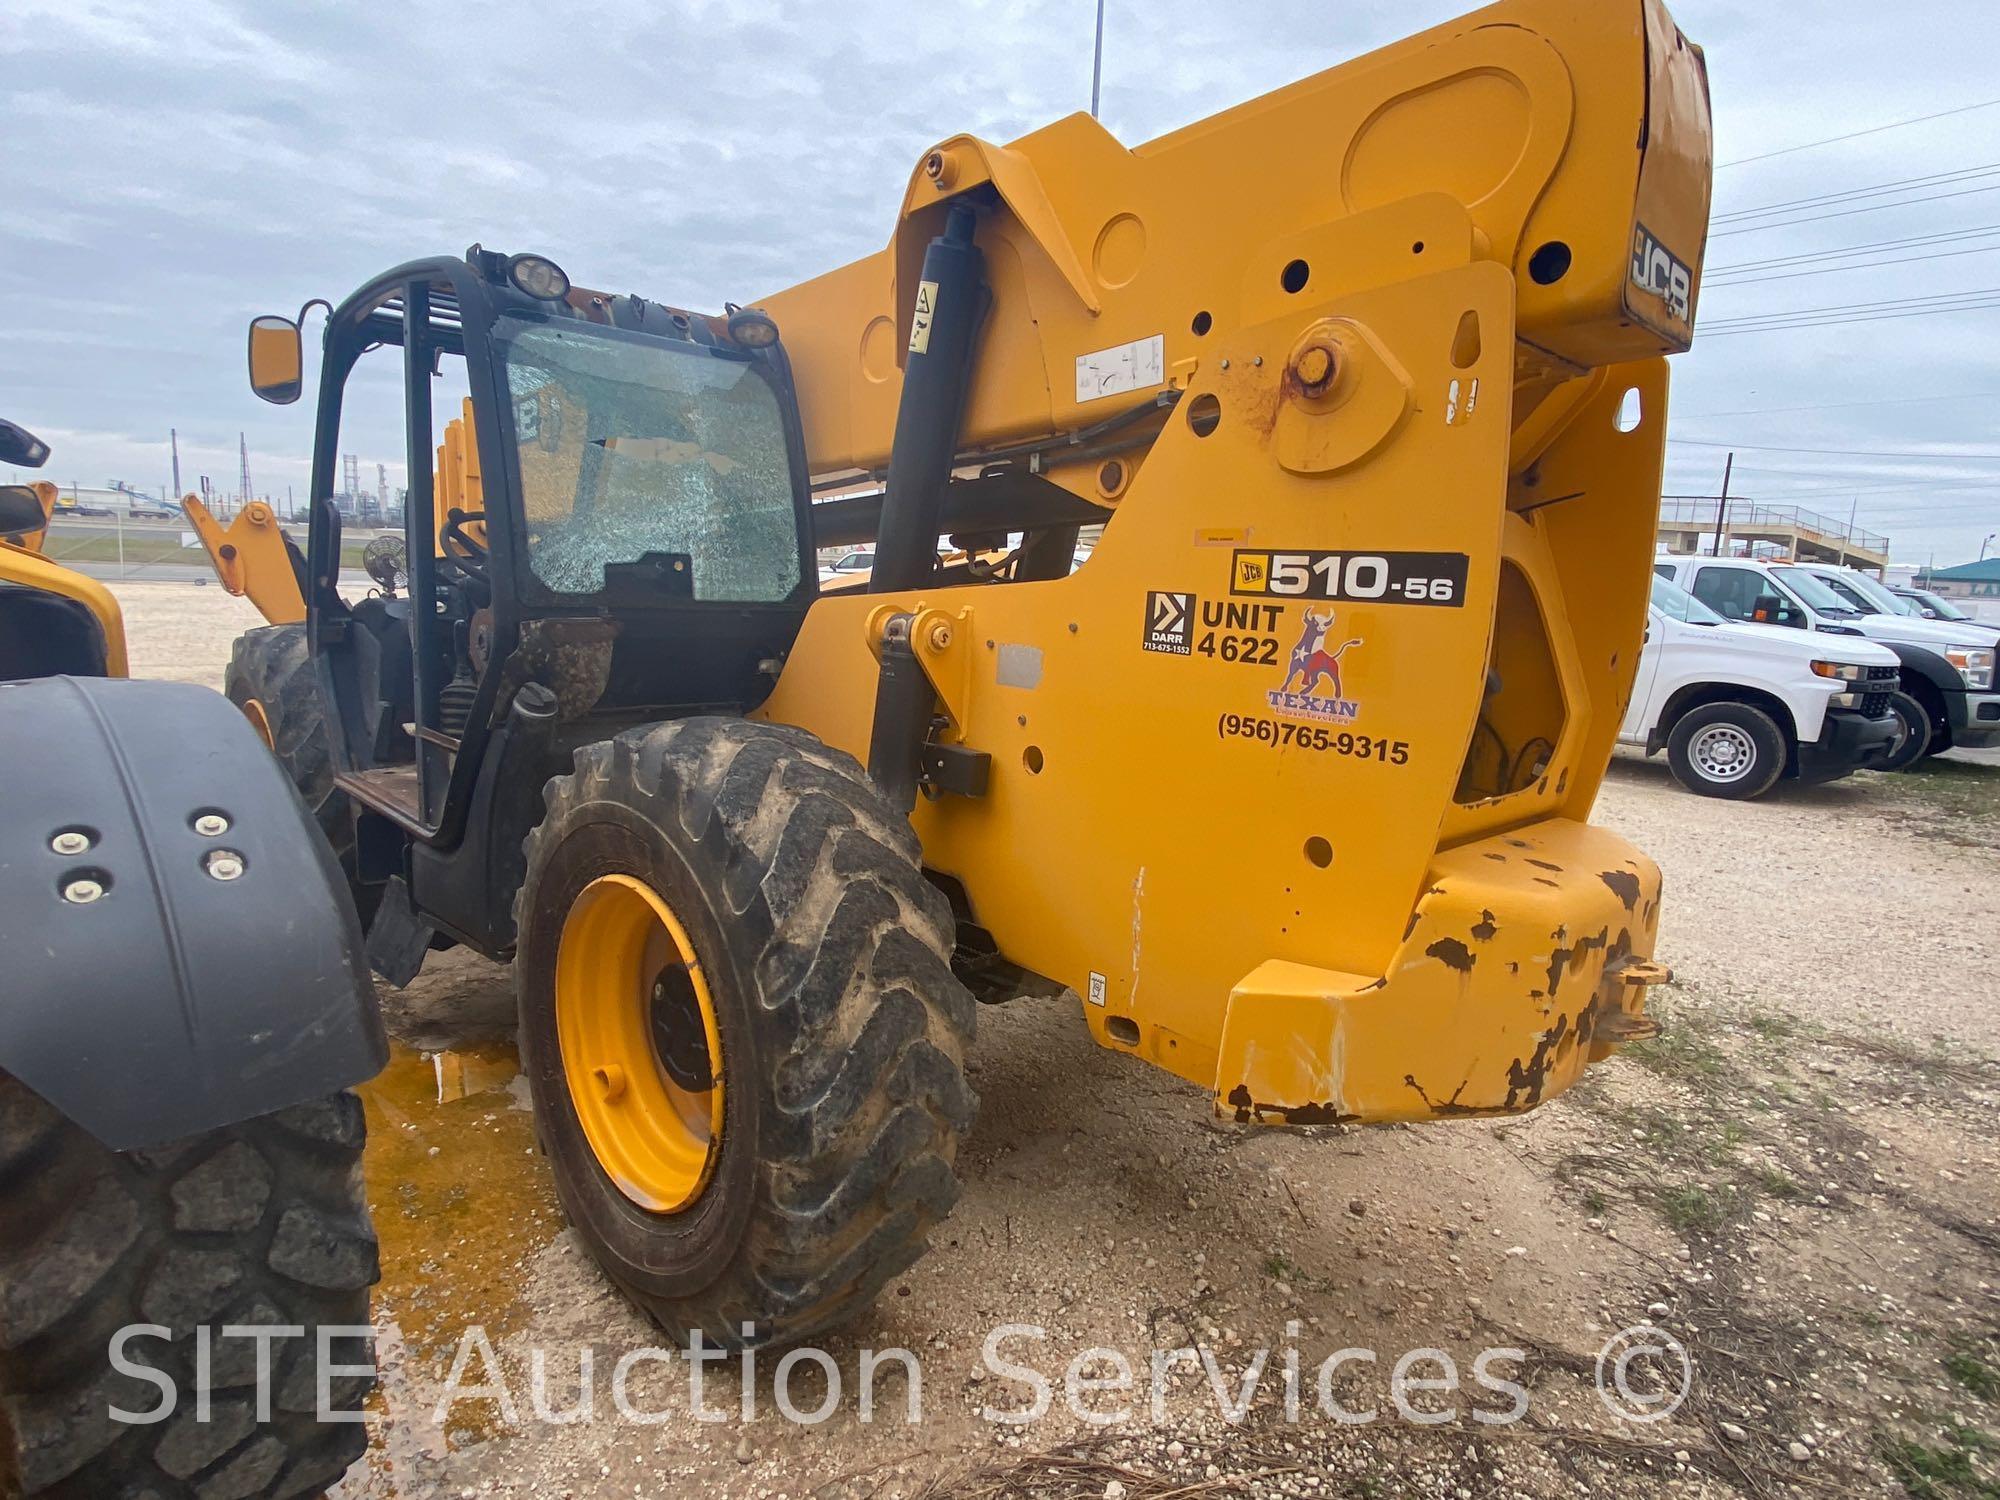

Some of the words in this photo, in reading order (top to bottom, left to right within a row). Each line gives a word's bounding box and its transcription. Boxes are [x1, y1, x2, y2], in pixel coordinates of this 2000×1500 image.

[1632, 237, 1690, 322] JCB
[1243, 563, 1262, 581] JCB
[1269, 555, 1454, 600] 510-56
[1202, 601, 1285, 632] UNIT
[1143, 641, 1190, 655] 713-675-1552
[1151, 631, 1184, 644] DARR
[1197, 631, 1279, 666] 4622
[1269, 691, 1358, 717] TEXAN
[1218, 713, 1410, 766] (956)765-9315
